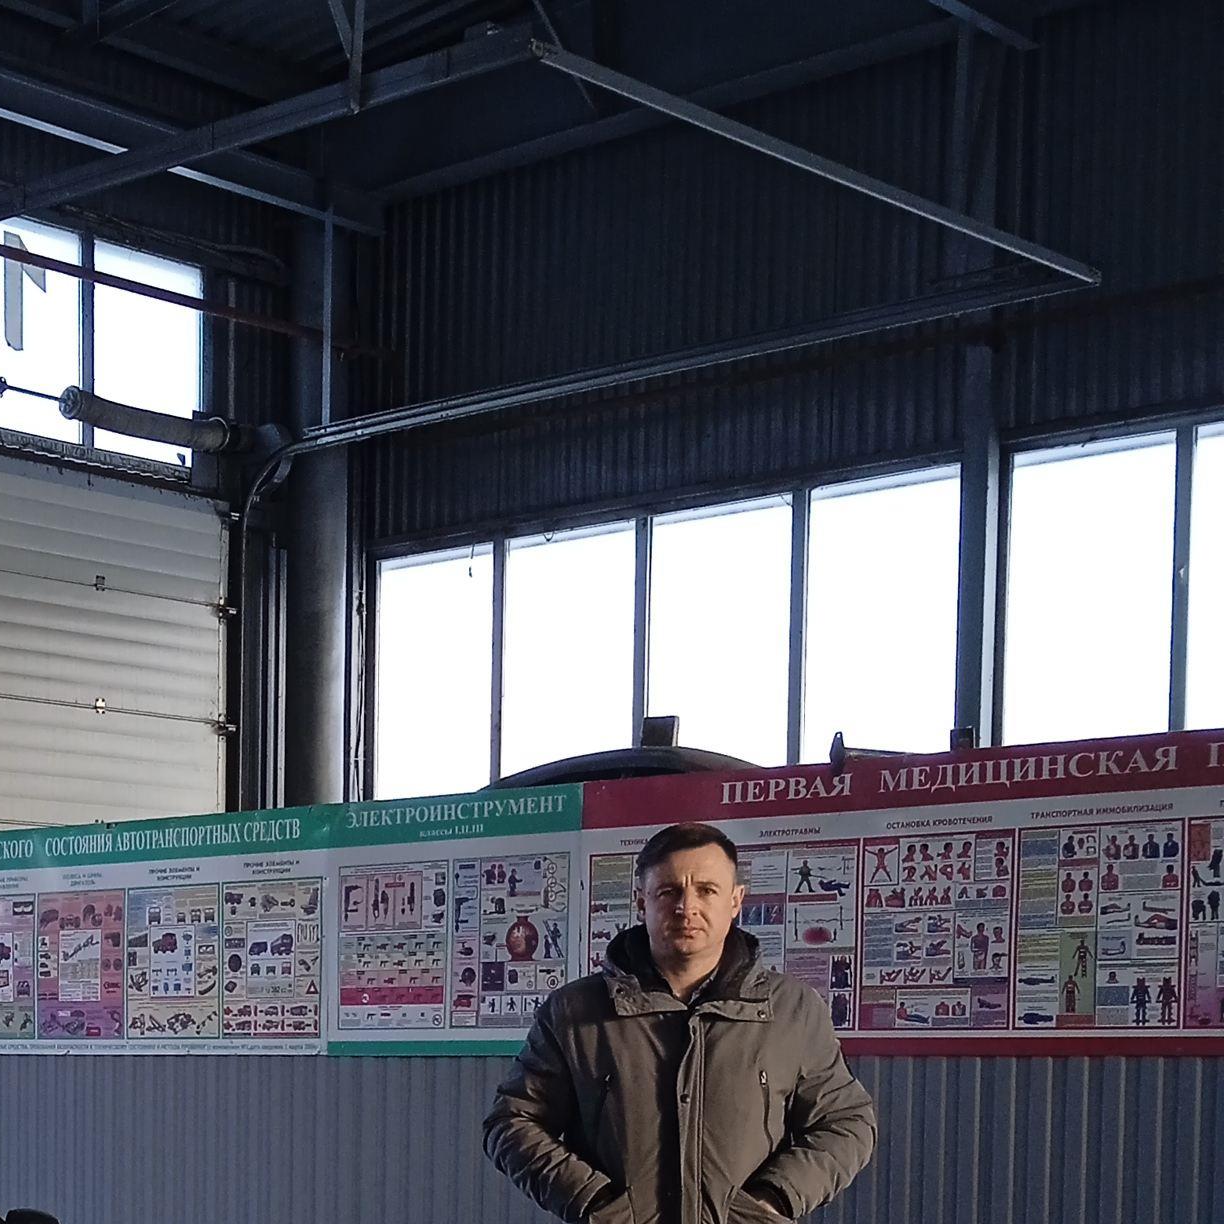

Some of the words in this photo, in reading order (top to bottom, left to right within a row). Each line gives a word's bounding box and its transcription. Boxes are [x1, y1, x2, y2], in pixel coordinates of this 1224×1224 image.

[720, 772, 854, 804] ПЕРВАЯ
[878, 746, 1178, 793] МЕДИЦИНСКАЯ
[345, 794, 567, 828] ЭЛЕКТРОИНСТРУМЕНТ
[886, 819, 931, 830] ОСТАНОВКА
[932, 815, 993, 827] КРОВОТЕЧЕНИЯ
[1031, 807, 1094, 820] ТРАНСПОРТНАЯ
[1095, 802, 1174, 816] ИММОБИЛИЗАЦИЯ
[45, 832, 113, 857] СОСТОЯНИЯ
[116, 822, 241, 851] АВТОТРАНСПОРТНЫХ
[243, 818, 301, 842] СРЕДСТВ
[759, 827, 821, 838] ЭЛЕКТРОТРАВМЫ
